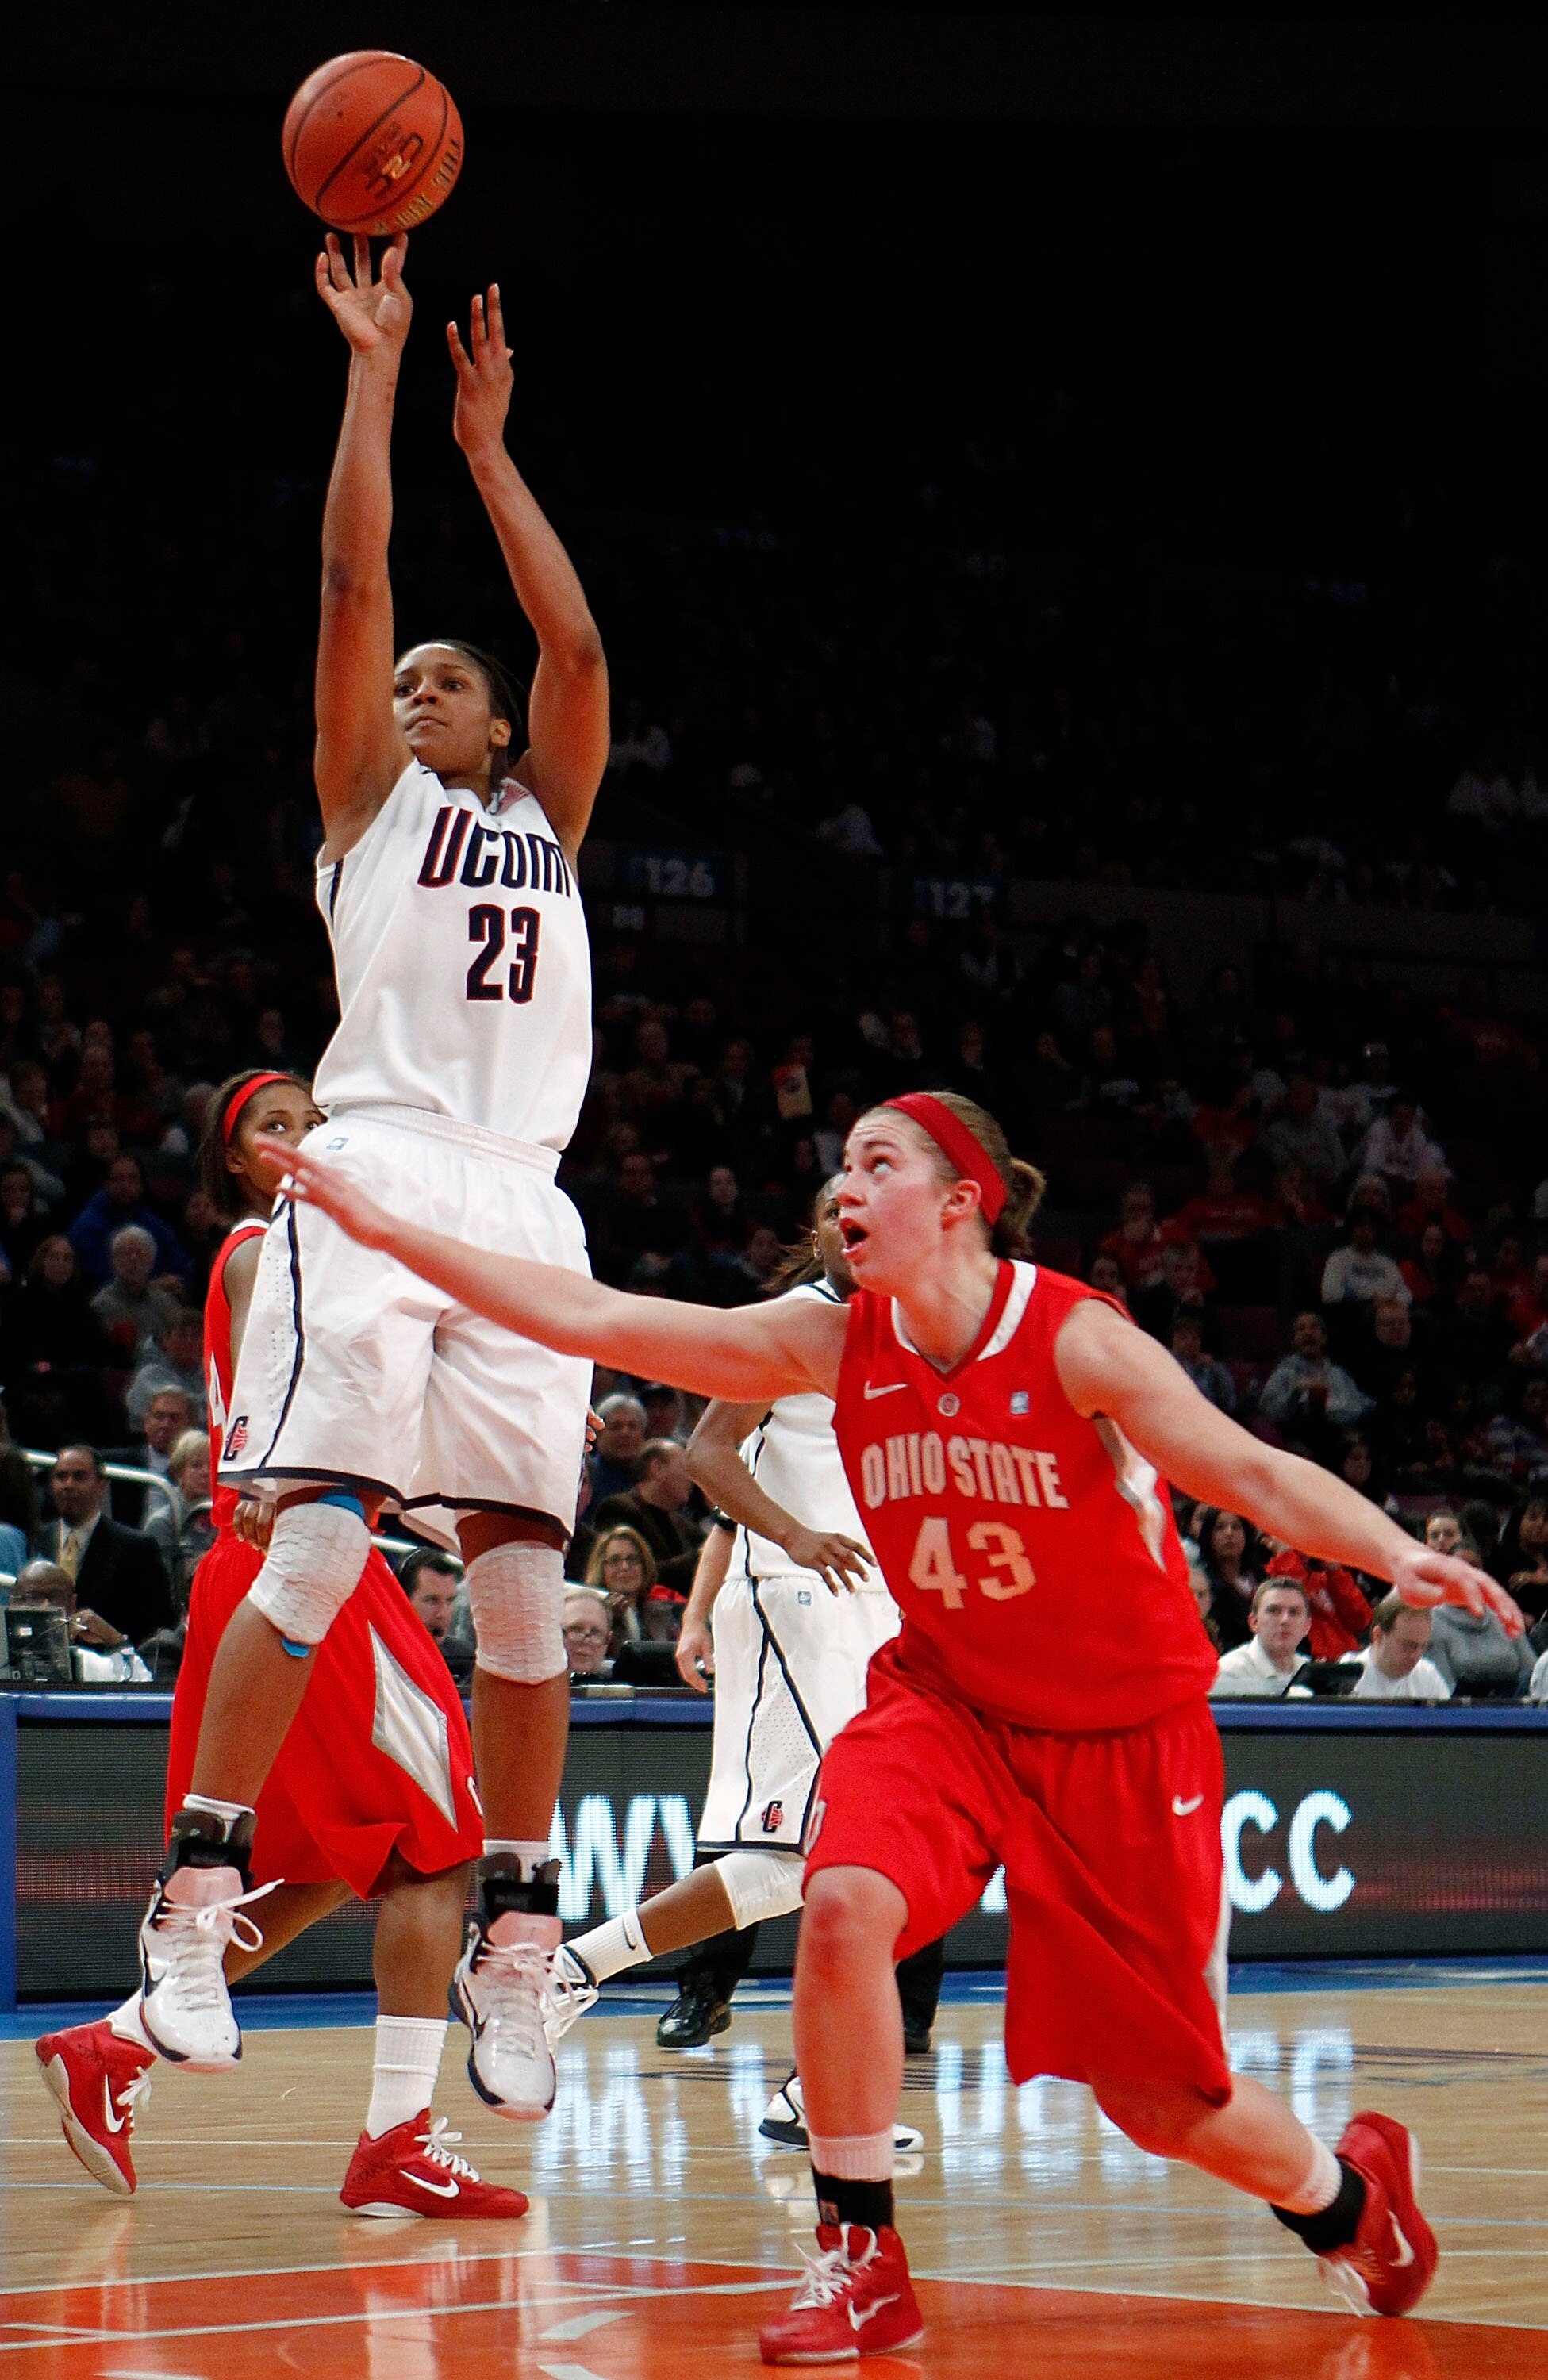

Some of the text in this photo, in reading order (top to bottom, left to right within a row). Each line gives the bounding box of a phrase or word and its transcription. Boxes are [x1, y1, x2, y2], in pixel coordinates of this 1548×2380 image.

[417, 805, 571, 900] UCONN
[645, 857, 715, 898] 126
[466, 903, 541, 1004] 23
[861, 1431, 1070, 1509] OHIO STATE
[908, 1516, 1037, 1610] 43
